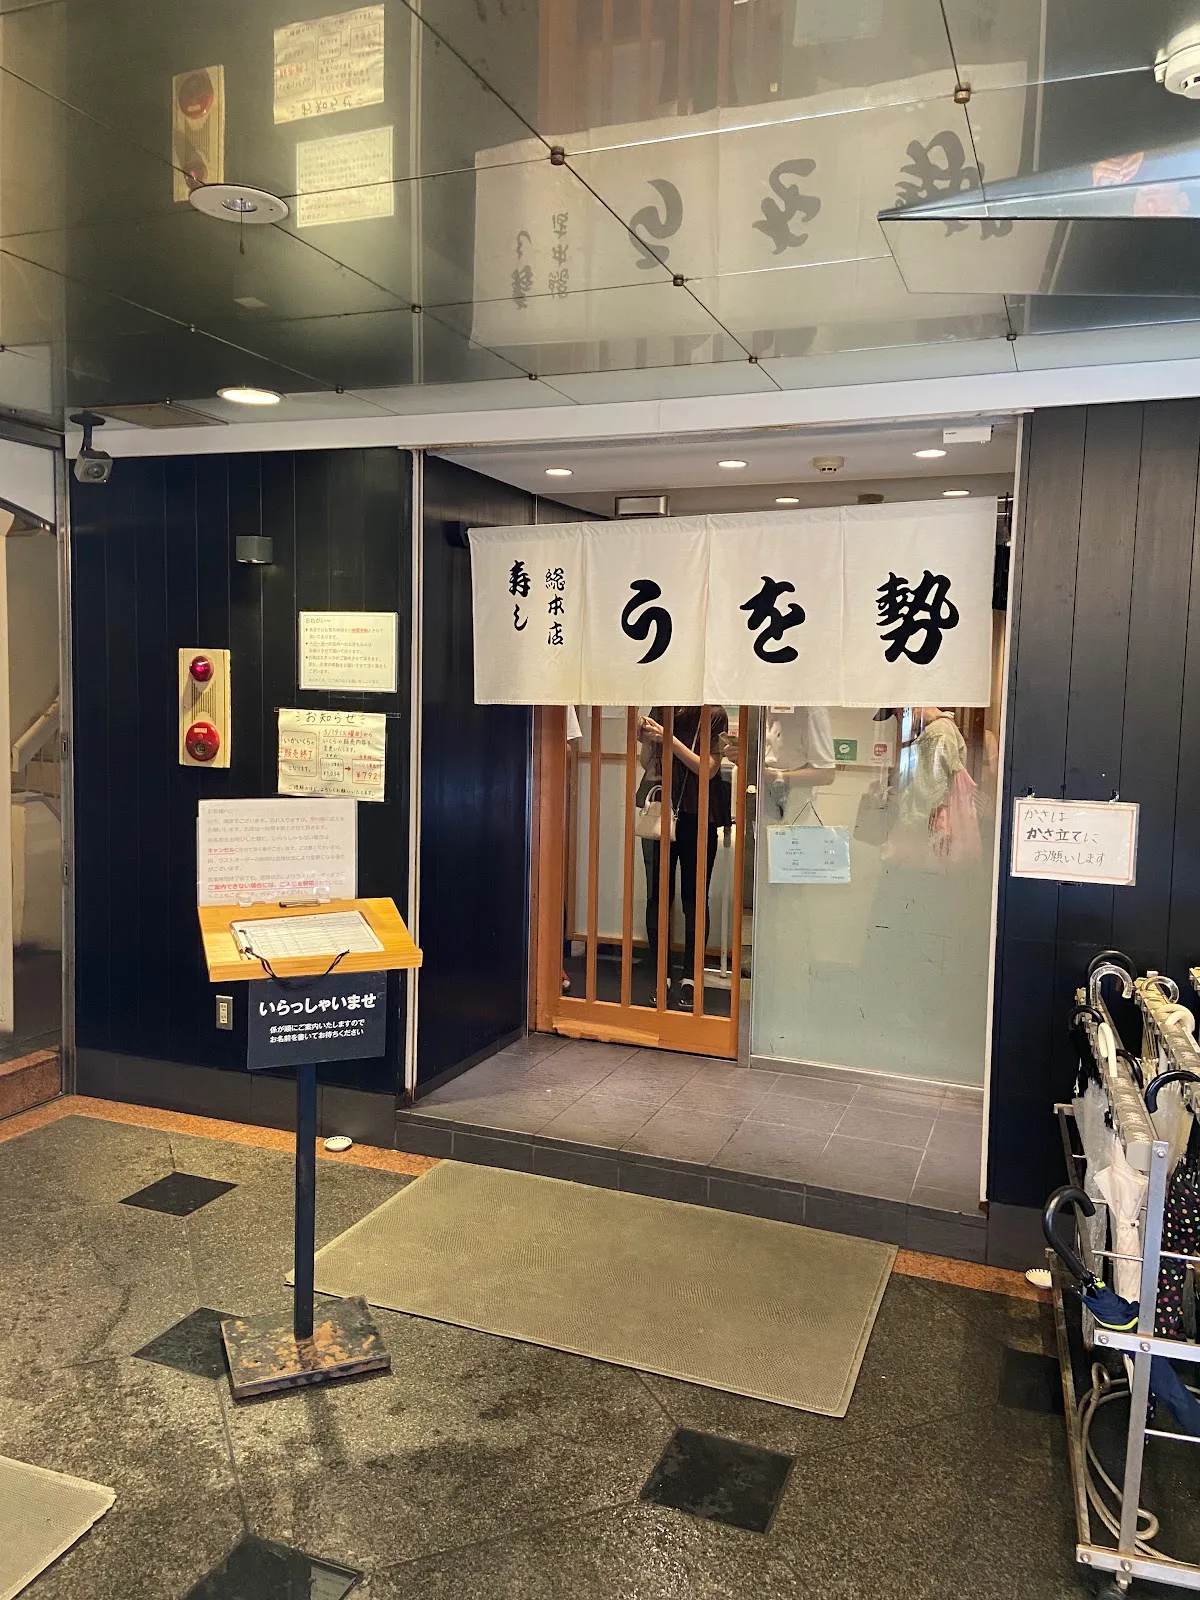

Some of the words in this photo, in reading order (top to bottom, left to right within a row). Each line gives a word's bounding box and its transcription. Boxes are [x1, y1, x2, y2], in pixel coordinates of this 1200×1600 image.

[508, 559, 531, 633] 寿し
[544, 567, 566, 647] 総本店
[306, 712, 356, 725] お知らせ
[283, 748, 313, 759] 販売終了
[1024, 807, 1069, 823] かさは
[1026, 826, 1100, 844] かさ立てに
[1034, 849, 1105, 868] お願いします
[259, 992, 377, 1016] いらっしゃいませ
[269, 1018, 365, 1034] 係が順にご案内いたしますので
[269, 1028, 365, 1043] お名前を書いてお待ちください
